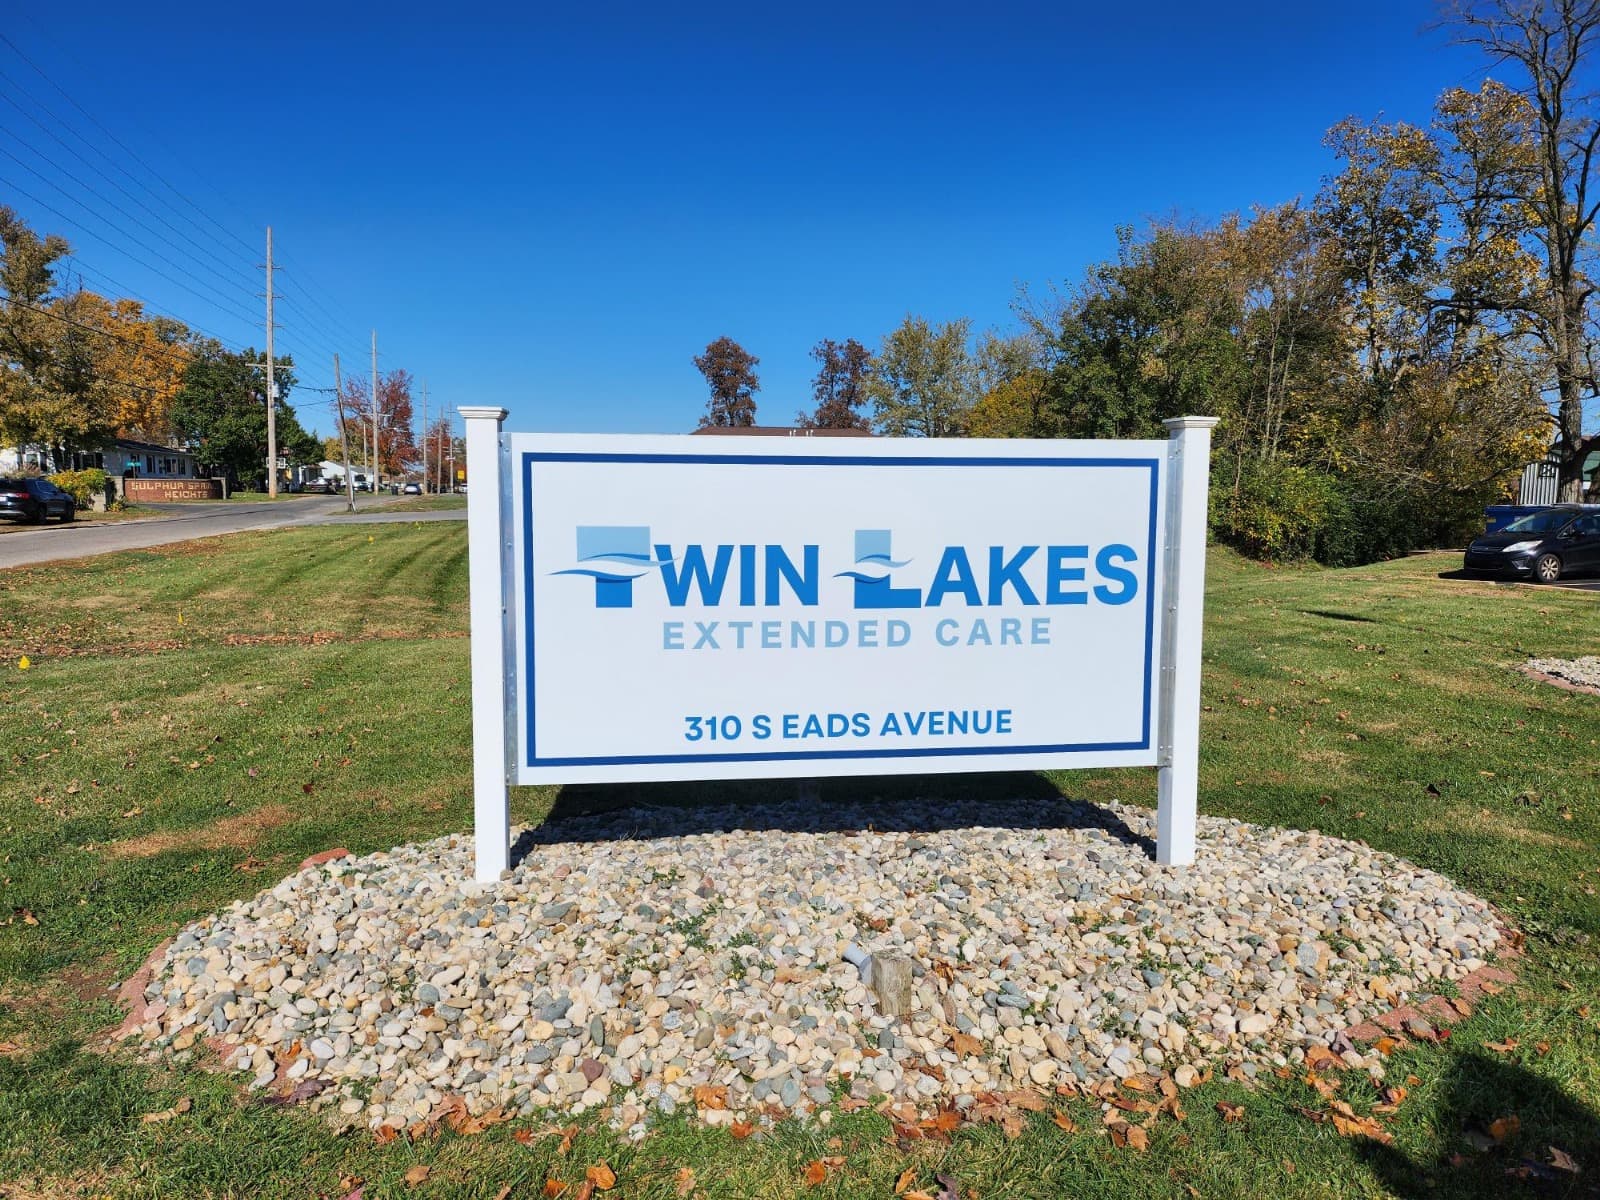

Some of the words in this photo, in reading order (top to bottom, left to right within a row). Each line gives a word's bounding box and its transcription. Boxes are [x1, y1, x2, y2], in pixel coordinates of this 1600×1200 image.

[131, 482, 185, 490] SULPHUR
[164, 490, 208, 499] HEIGHTS
[575, 525, 820, 609] TWIN
[853, 529, 1139, 609] LAKES
[663, 619, 912, 650] EXTENDED
[935, 617, 1051, 647] CARE
[684, 715, 742, 741] 310
[751, 714, 772, 740] S
[782, 712, 871, 738] EADS
[879, 709, 1012, 736] AVENUE
